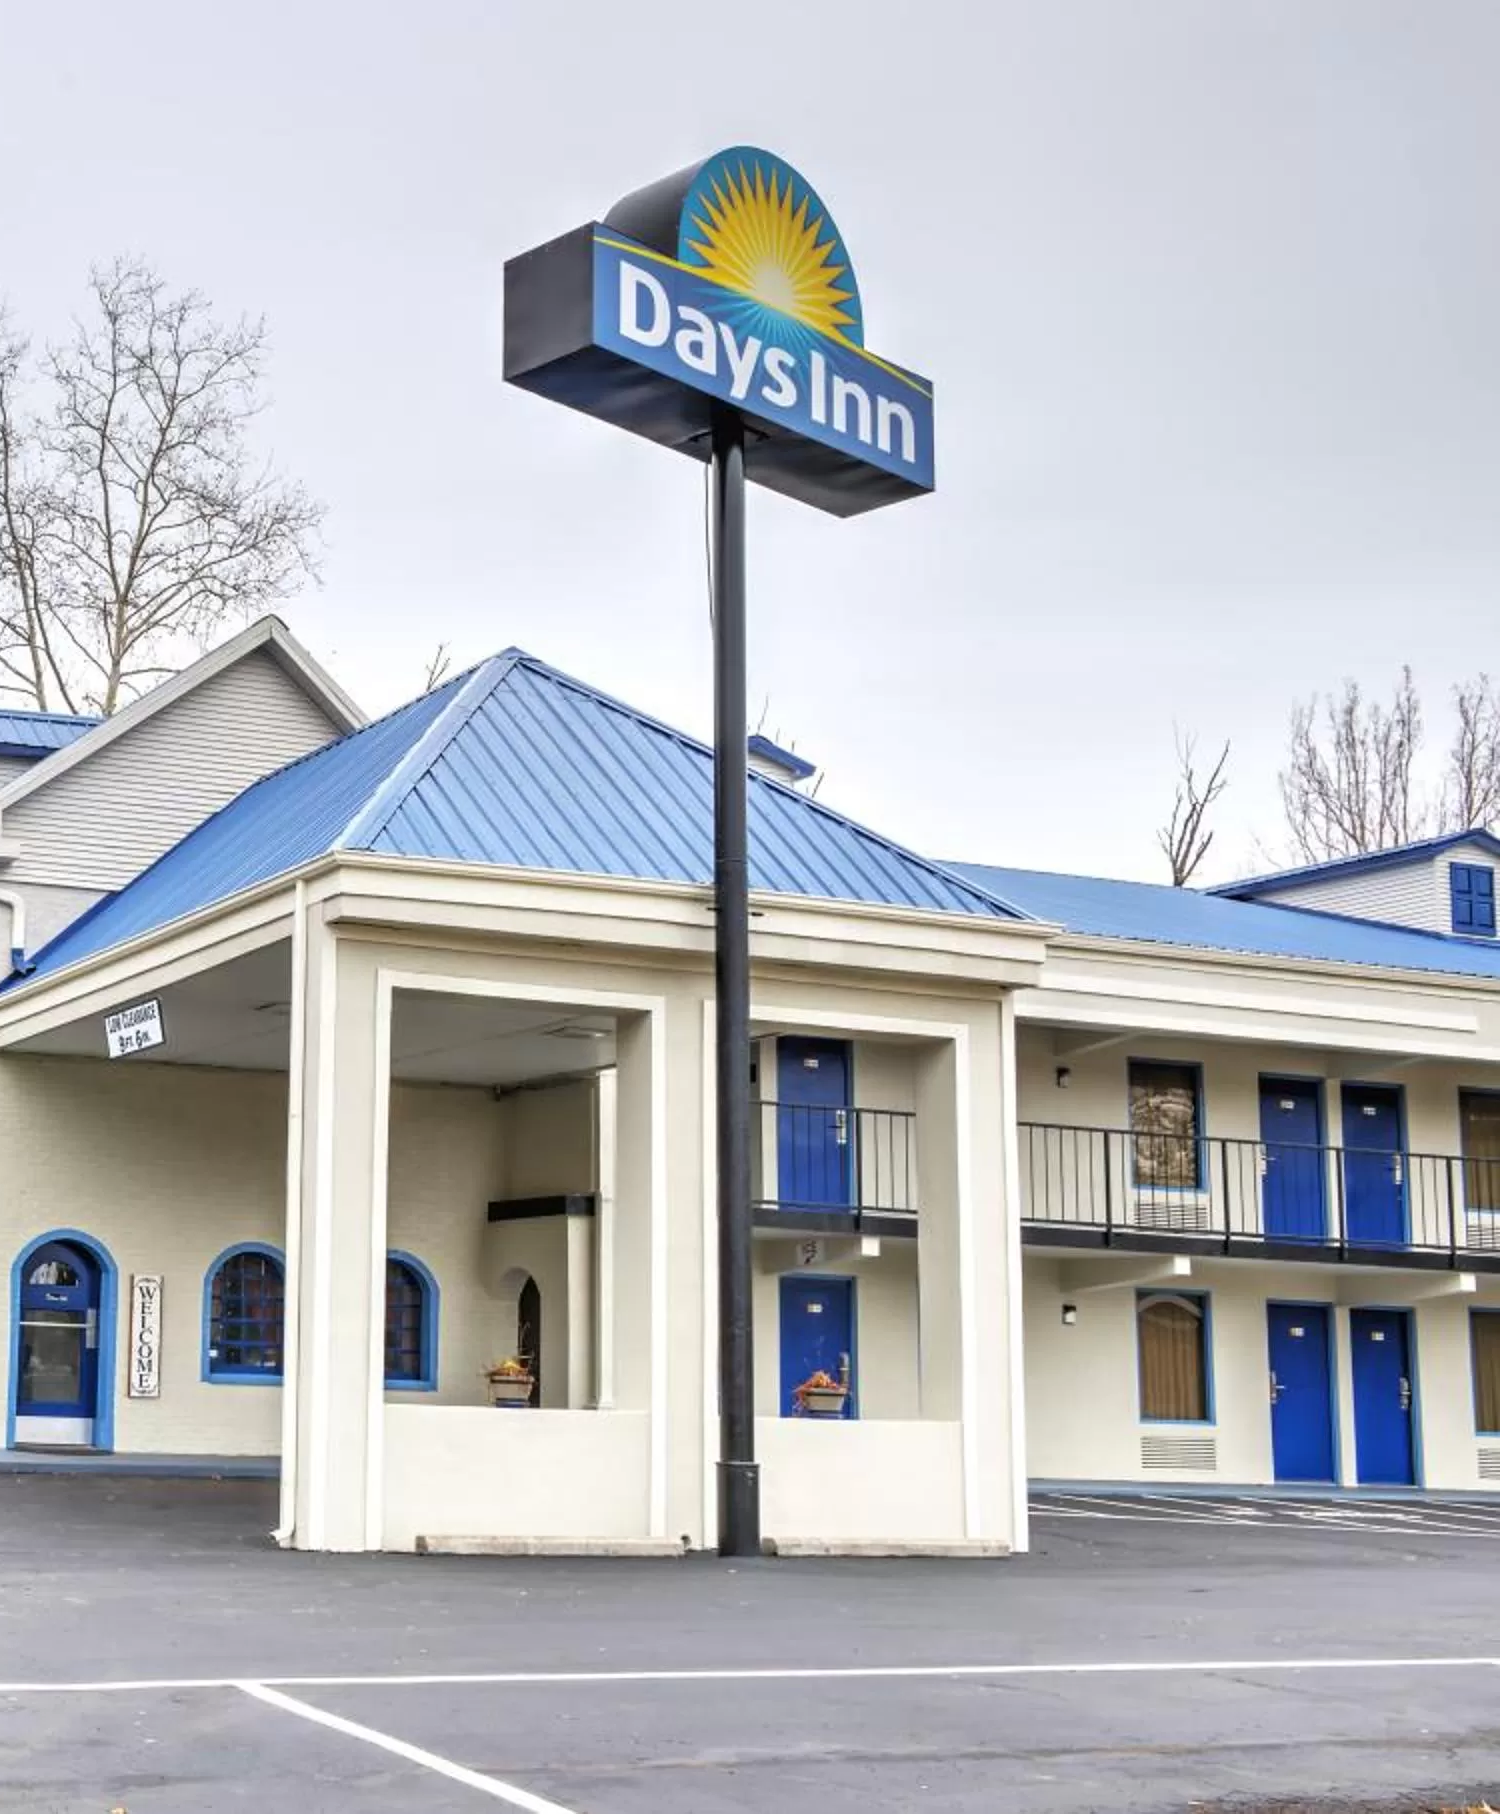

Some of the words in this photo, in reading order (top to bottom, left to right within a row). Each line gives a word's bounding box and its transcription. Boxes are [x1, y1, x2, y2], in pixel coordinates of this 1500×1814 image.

[618, 259, 798, 408] Days
[810, 350, 917, 464] Inn
[137, 1285, 157, 1389] WELCOME
